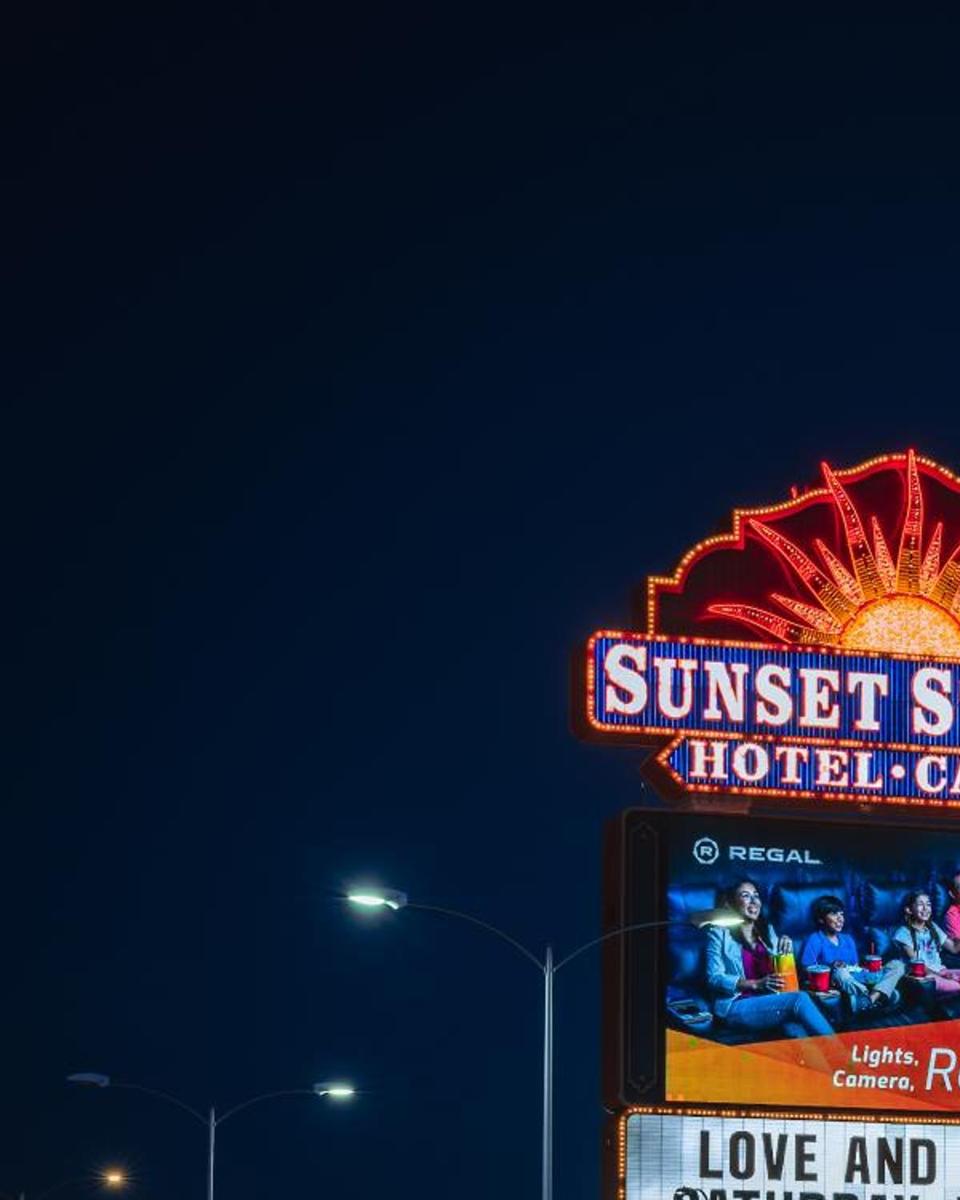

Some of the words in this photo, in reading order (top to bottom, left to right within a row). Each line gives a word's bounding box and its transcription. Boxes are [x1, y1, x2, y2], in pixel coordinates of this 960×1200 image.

[605, 643, 889, 731] SUNSET
[690, 740, 884, 789] HOTEL
[729, 845, 824, 865] REGAL
[852, 1045, 919, 1068] Lights,
[833, 1070, 915, 1092] Camera,
[699, 1130, 818, 1182] LOVE
[844, 1135, 937, 1186] AND
